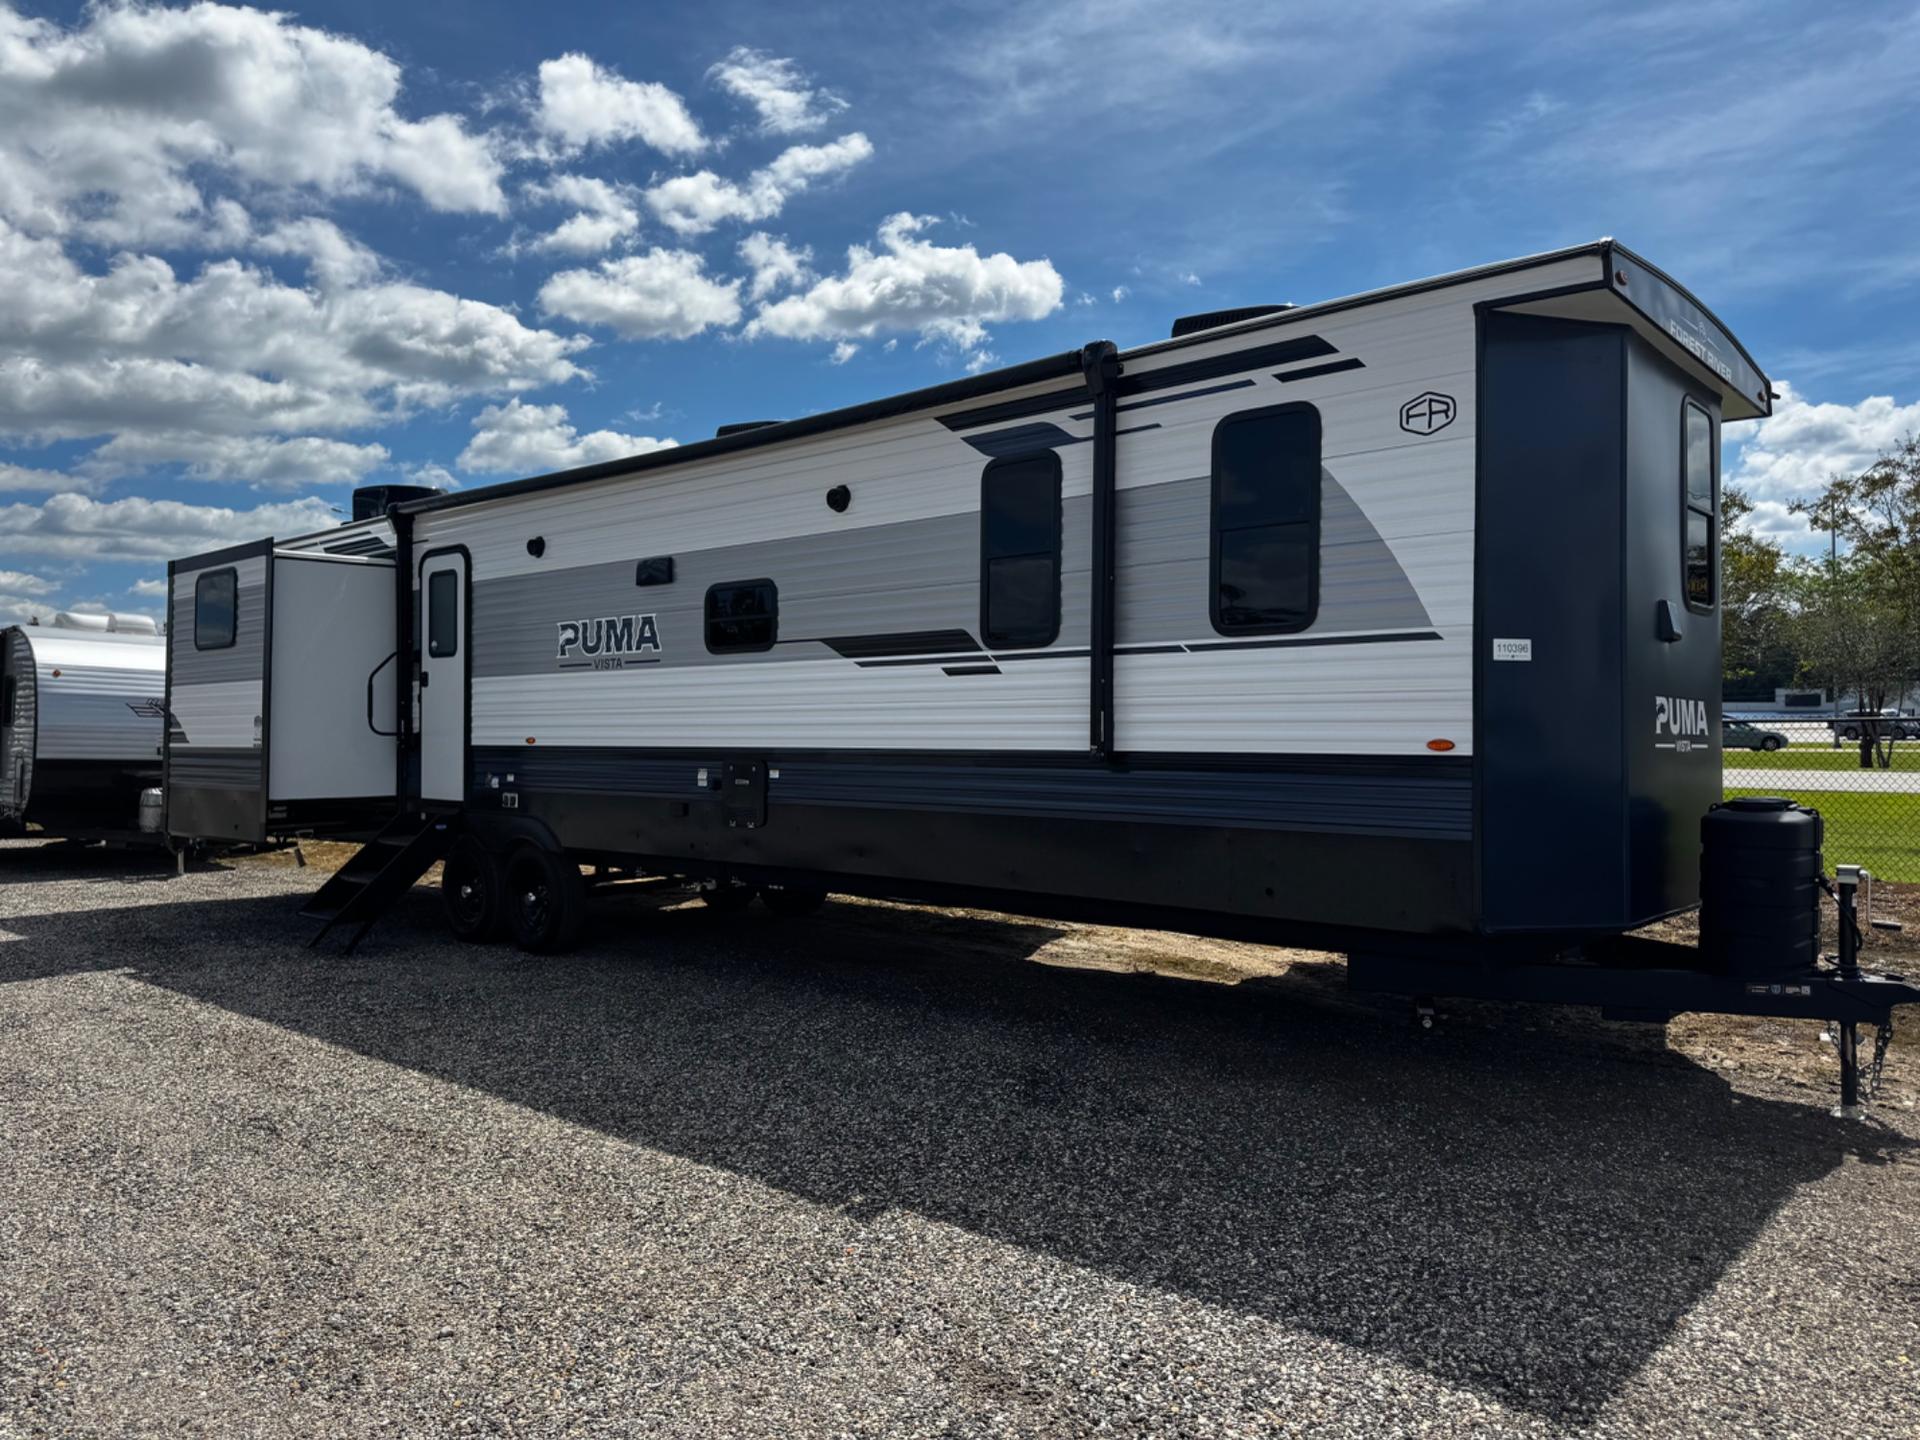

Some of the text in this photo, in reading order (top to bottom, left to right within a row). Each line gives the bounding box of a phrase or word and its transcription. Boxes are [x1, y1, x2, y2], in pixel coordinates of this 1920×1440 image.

[1670, 319, 1706, 361] FOREST
[1707, 351, 1732, 381] RIVER
[1405, 398, 1450, 429] FR
[556, 613, 662, 659] PUMA
[593, 657, 623, 670] VISTA
[1655, 695, 1709, 736] PUMA
